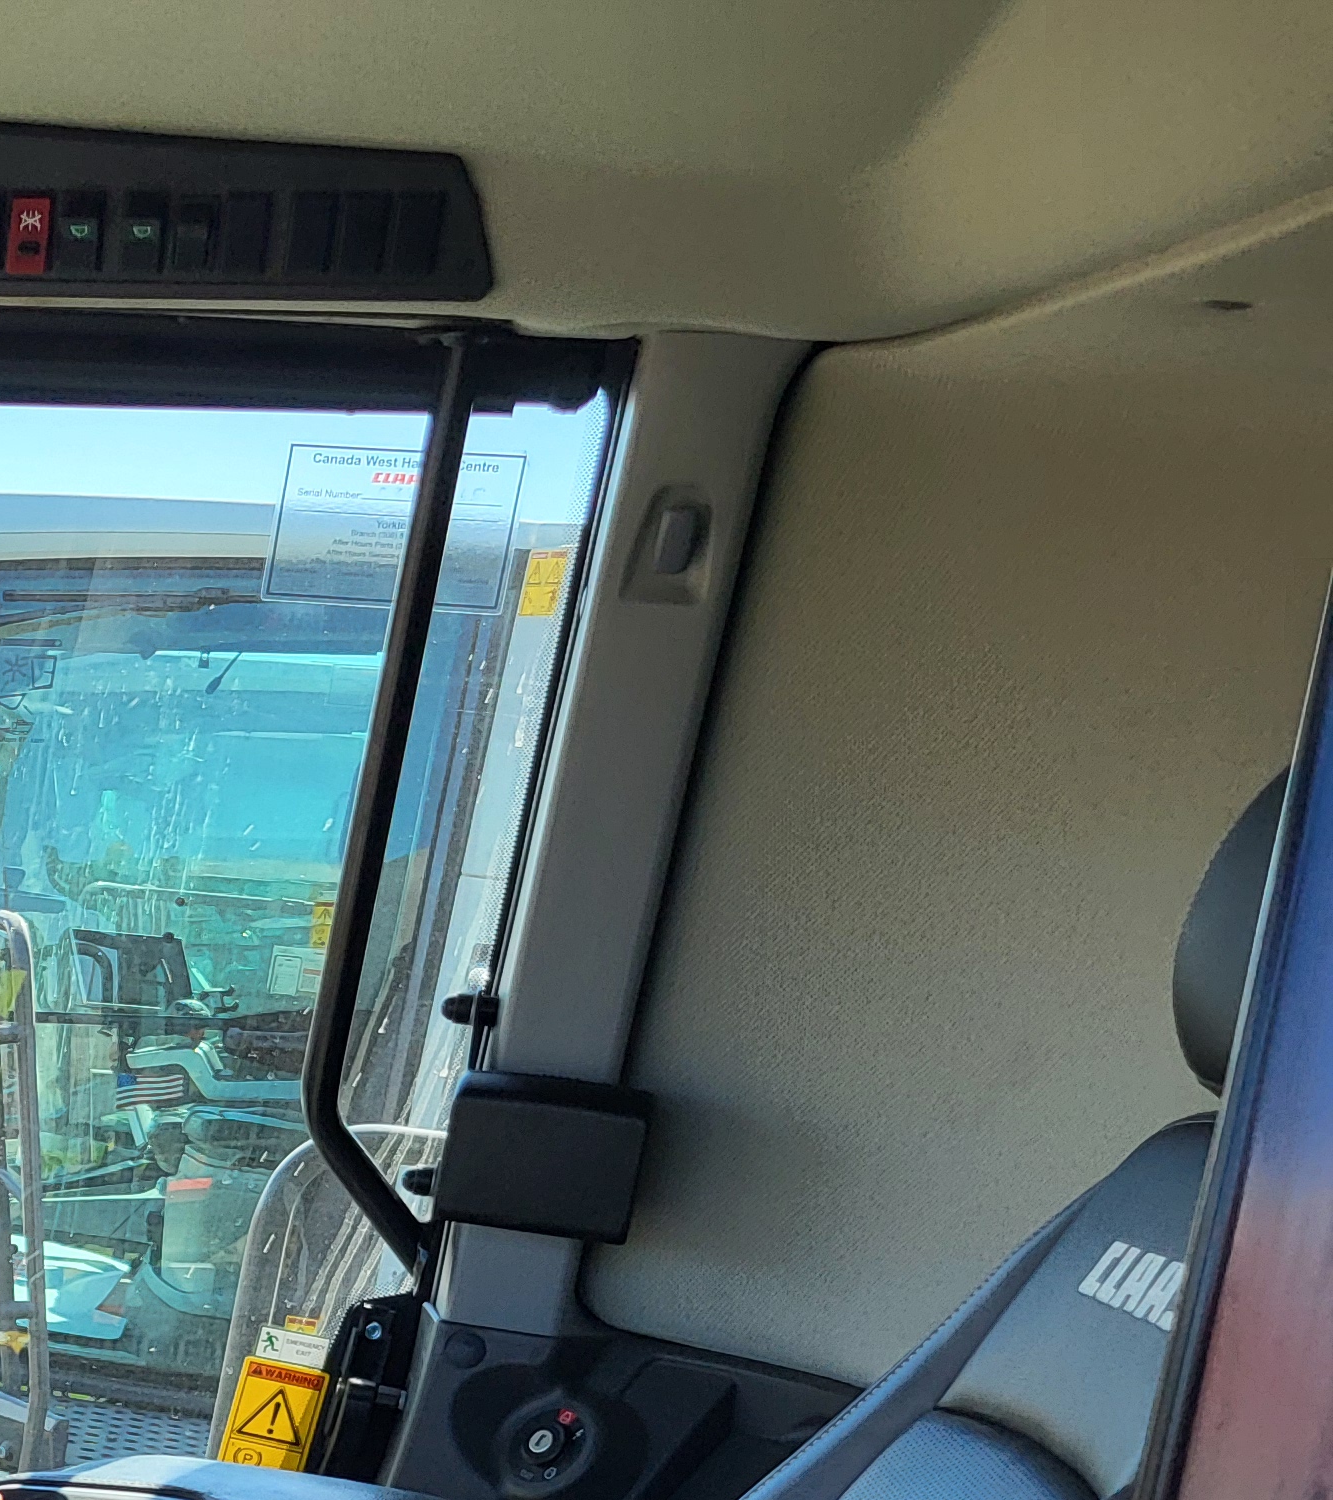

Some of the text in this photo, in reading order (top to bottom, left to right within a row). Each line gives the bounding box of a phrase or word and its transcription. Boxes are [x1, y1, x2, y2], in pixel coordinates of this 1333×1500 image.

[313, 453, 361, 466] Canada
[366, 455, 398, 468] West
[371, 472, 419, 485] CLAA
[297, 487, 323, 498] Serial
[376, 520, 407, 530] Yorkto
[286, 1338, 326, 1351] EMERGENCY
[295, 1349, 312, 1357] EXIT
[265, 1368, 320, 1388] WARNING
